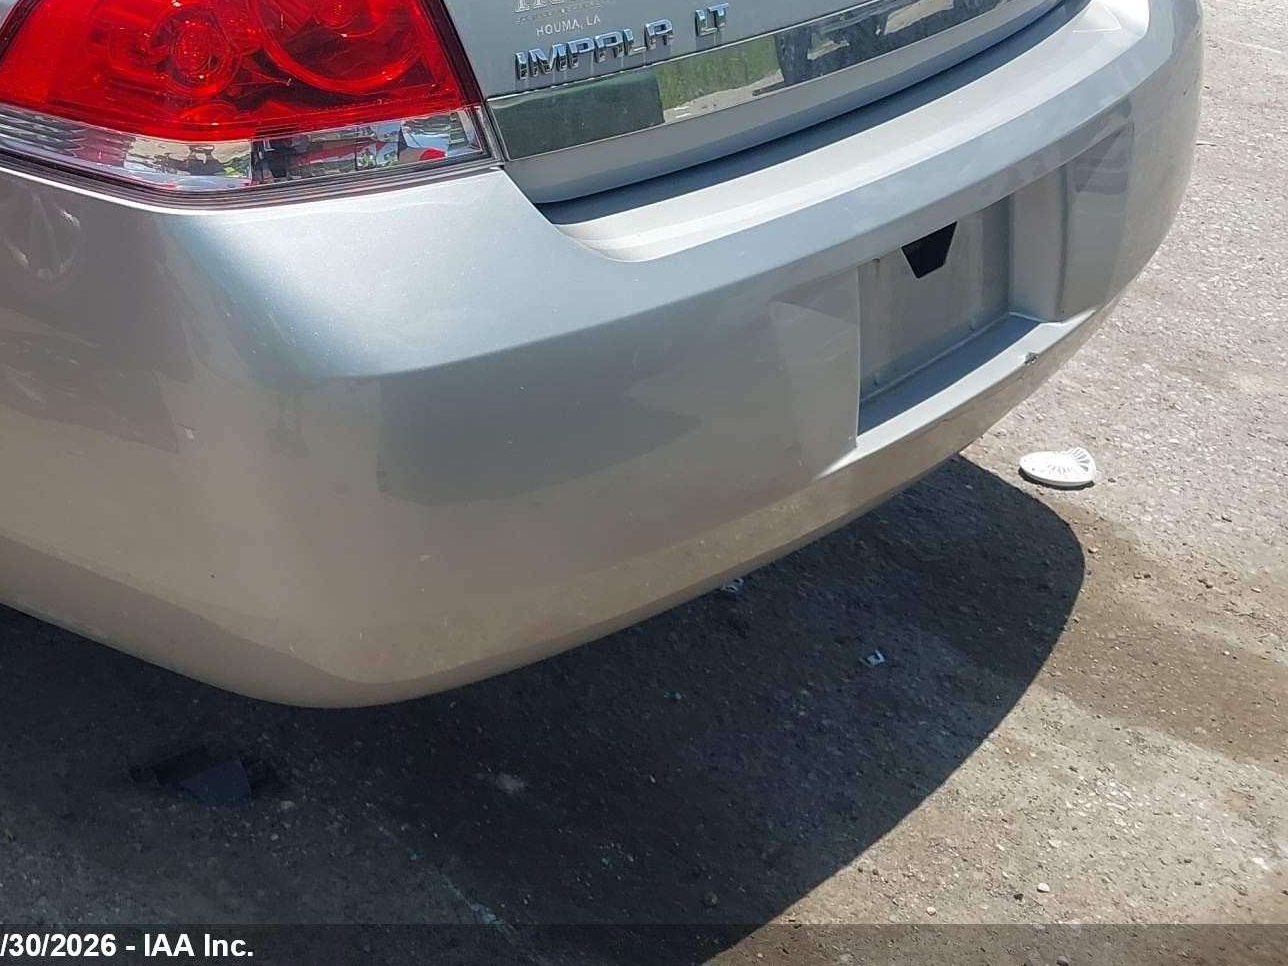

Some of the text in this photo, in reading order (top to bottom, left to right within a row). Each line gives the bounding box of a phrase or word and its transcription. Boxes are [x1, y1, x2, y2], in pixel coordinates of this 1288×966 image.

[514, 2, 730, 81] IMPALA LT
[536, 13, 601, 37] HOUMA, LA
